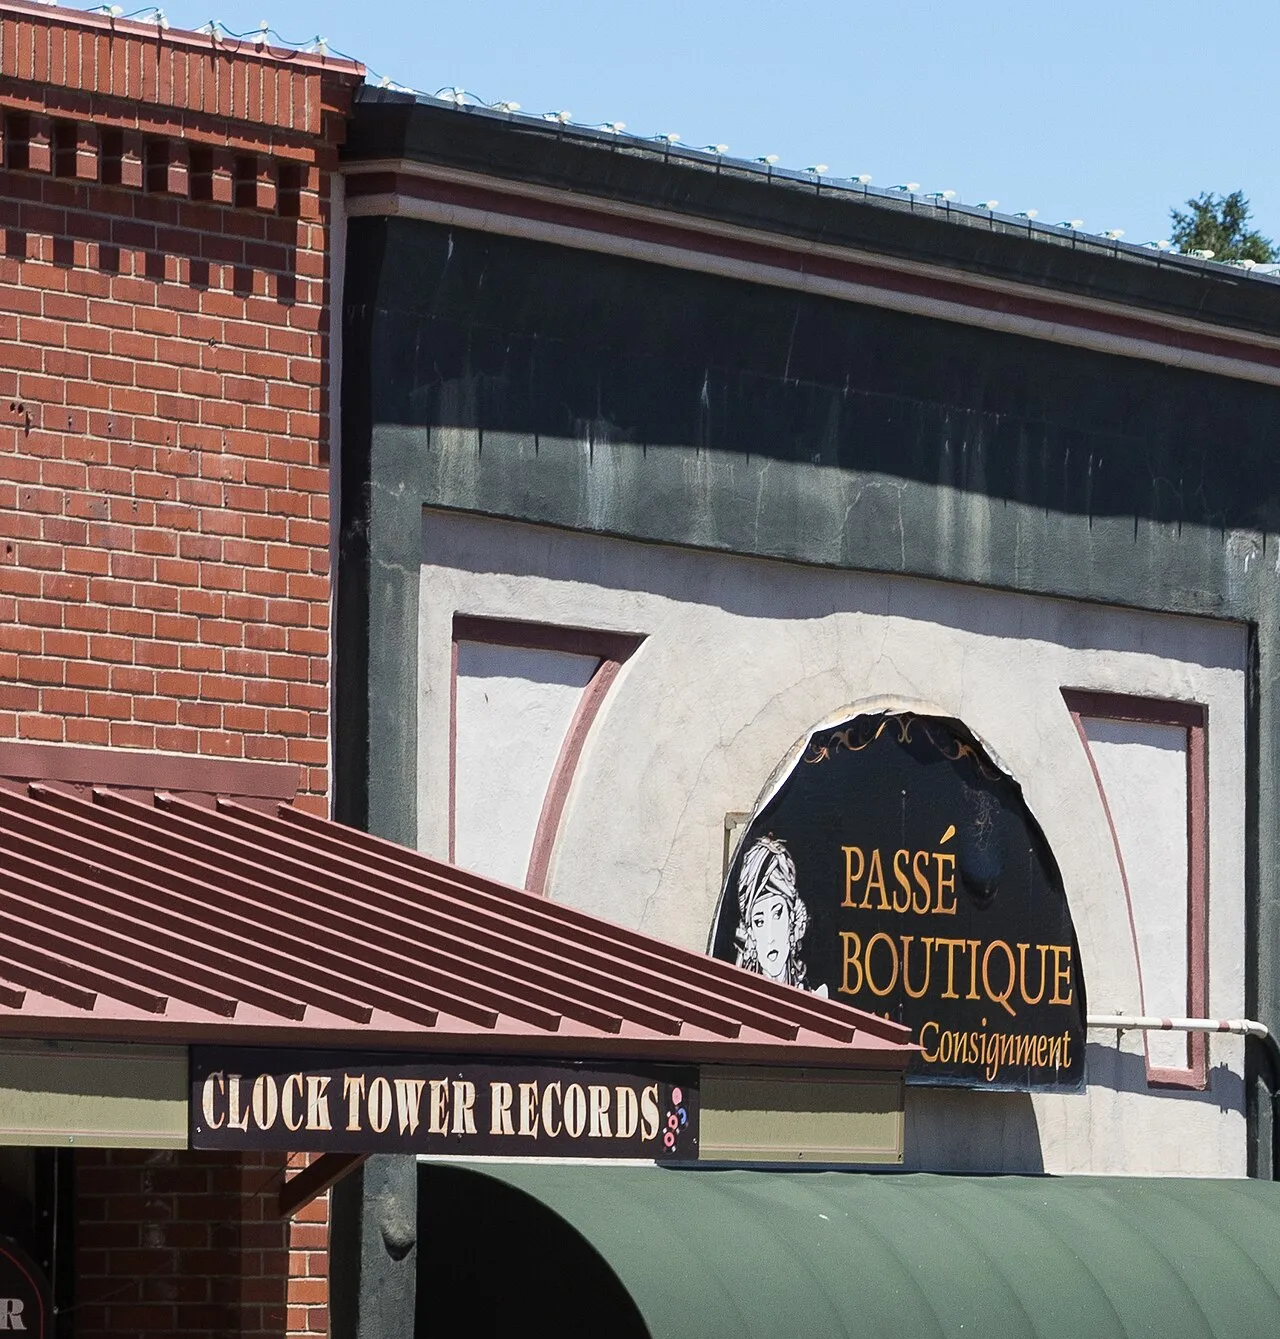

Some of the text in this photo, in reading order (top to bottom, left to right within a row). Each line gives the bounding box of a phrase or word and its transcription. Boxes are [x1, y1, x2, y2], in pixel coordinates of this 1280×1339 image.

[841, 824, 957, 915] PASSÉ
[837, 931, 1073, 1017] BOUTIQUE
[919, 1016, 1072, 1082] Consignment
[202, 1070, 660, 1143] CLOCK TOWER RECORDS
